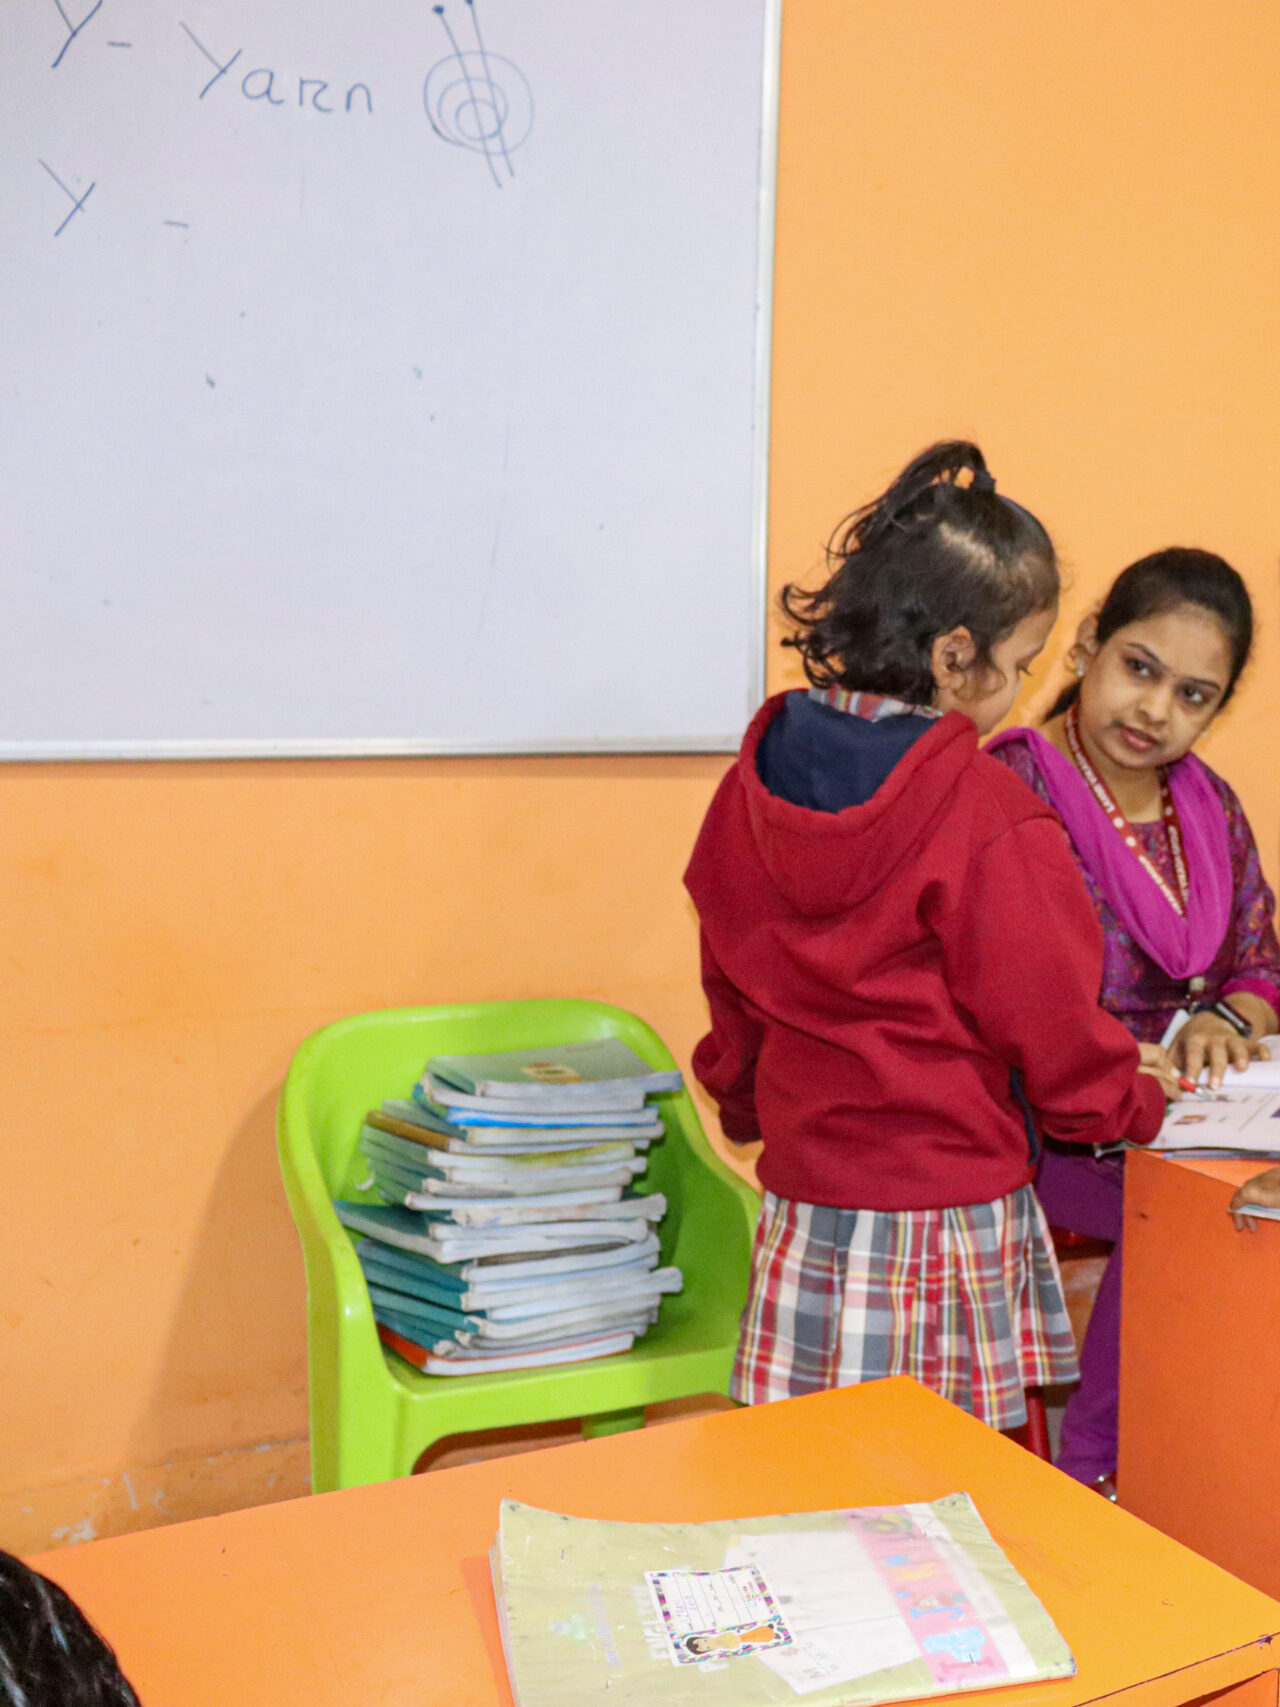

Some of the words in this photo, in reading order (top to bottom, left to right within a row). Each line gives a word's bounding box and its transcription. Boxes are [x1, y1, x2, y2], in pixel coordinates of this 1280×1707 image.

[51, 0, 102, 68] Y
[179, 21, 373, 114] Yarn
[37, 158, 96, 237] Y
